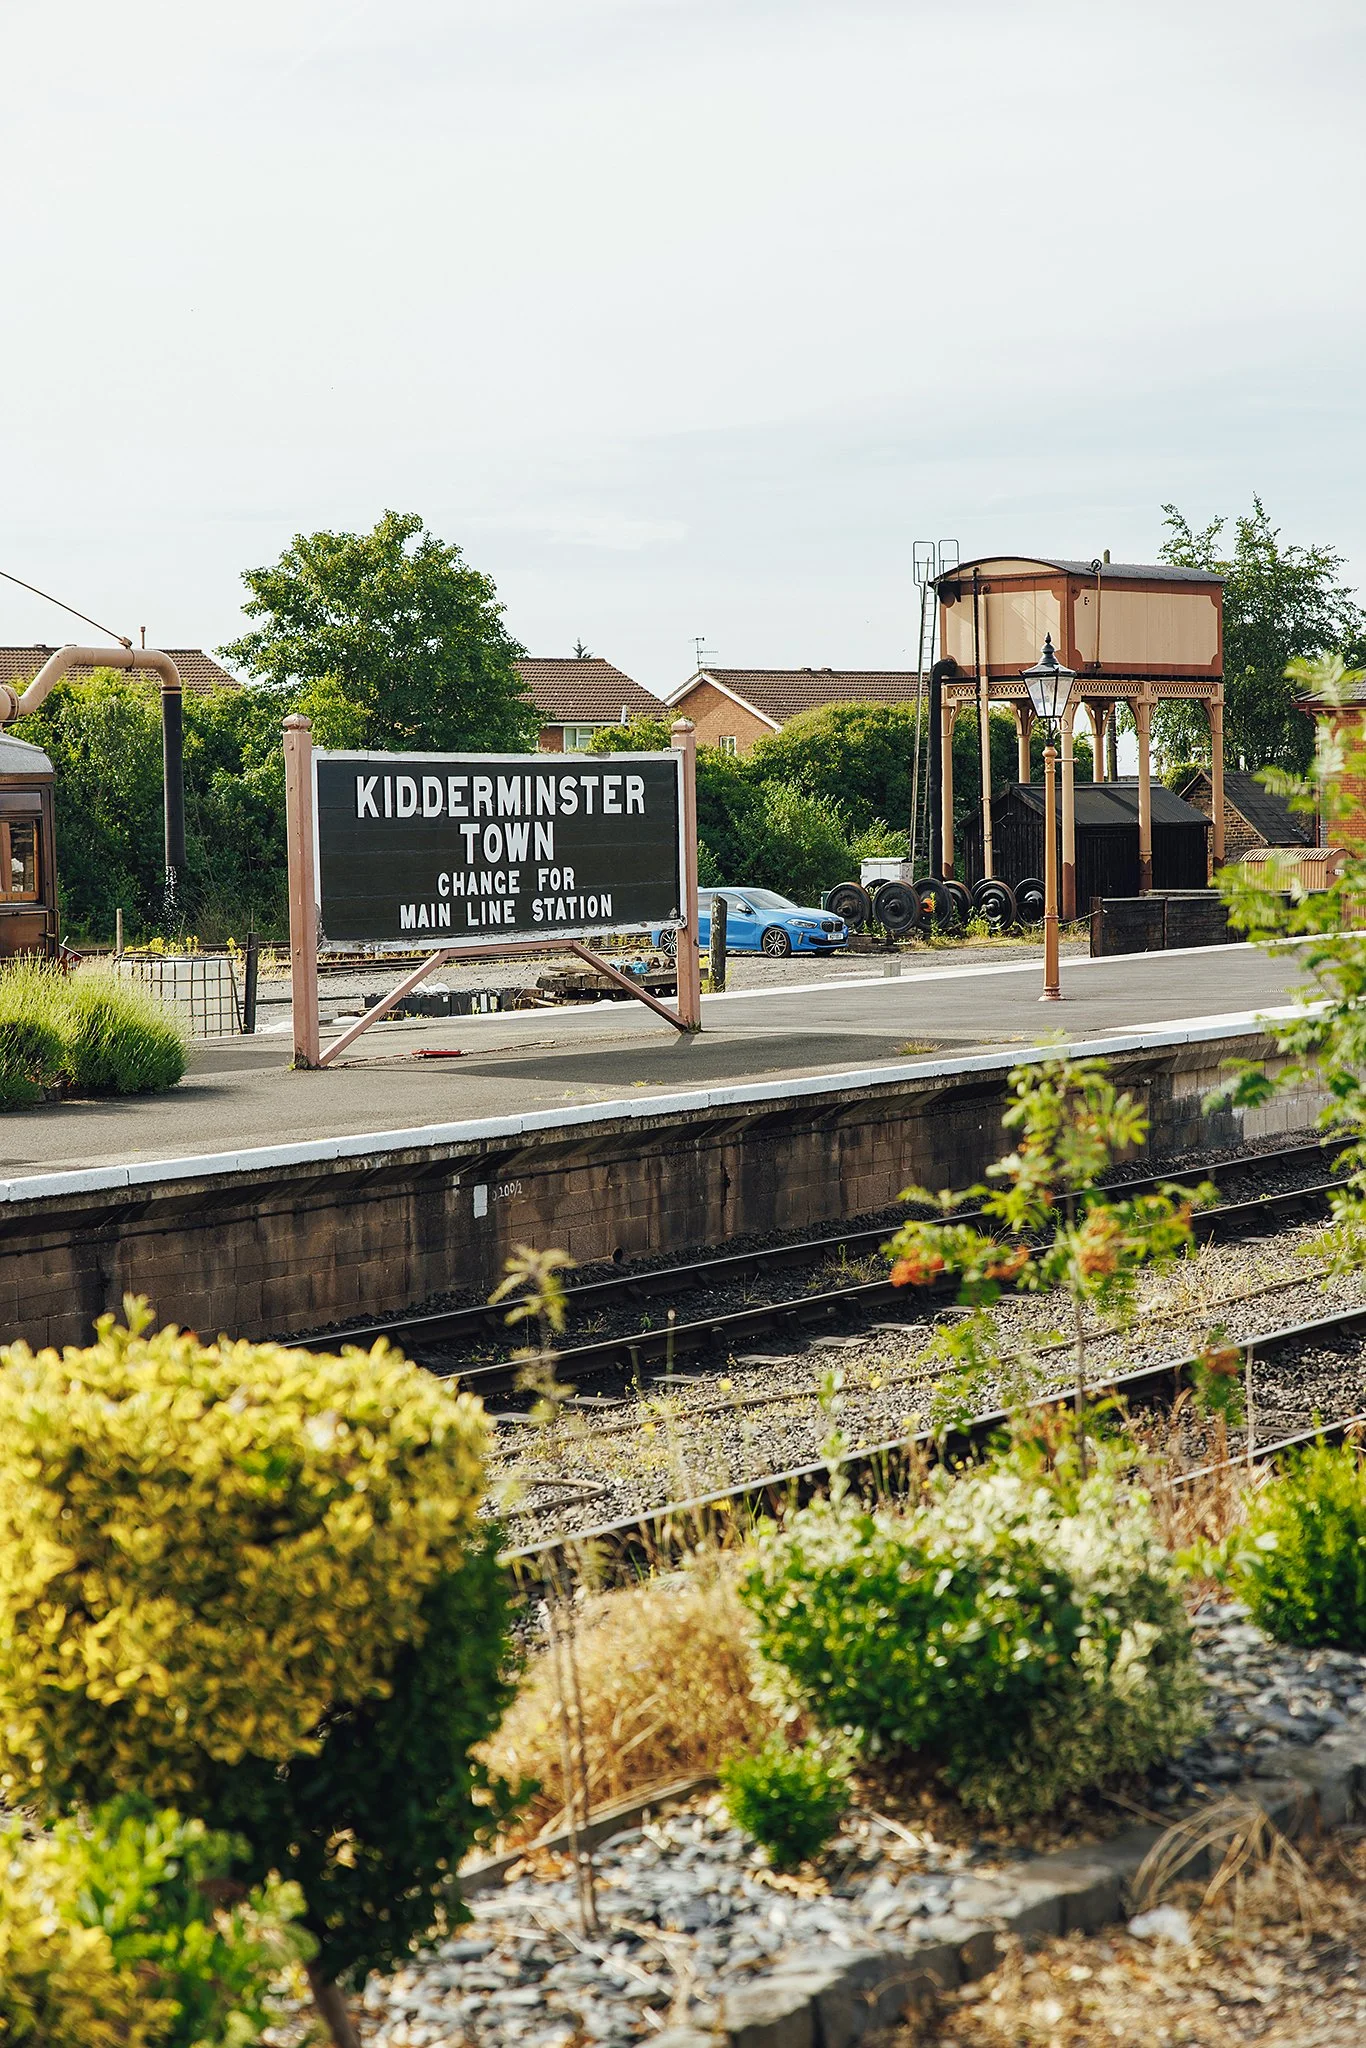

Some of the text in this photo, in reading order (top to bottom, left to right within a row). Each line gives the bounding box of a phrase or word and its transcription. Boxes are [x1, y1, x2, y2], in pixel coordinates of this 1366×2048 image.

[357, 775, 646, 818] KIDDERMINSTER
[460, 822, 554, 864] TOWN
[437, 867, 575, 897] CHANGE FOR
[400, 895, 612, 930] MAIN LINE STATION
